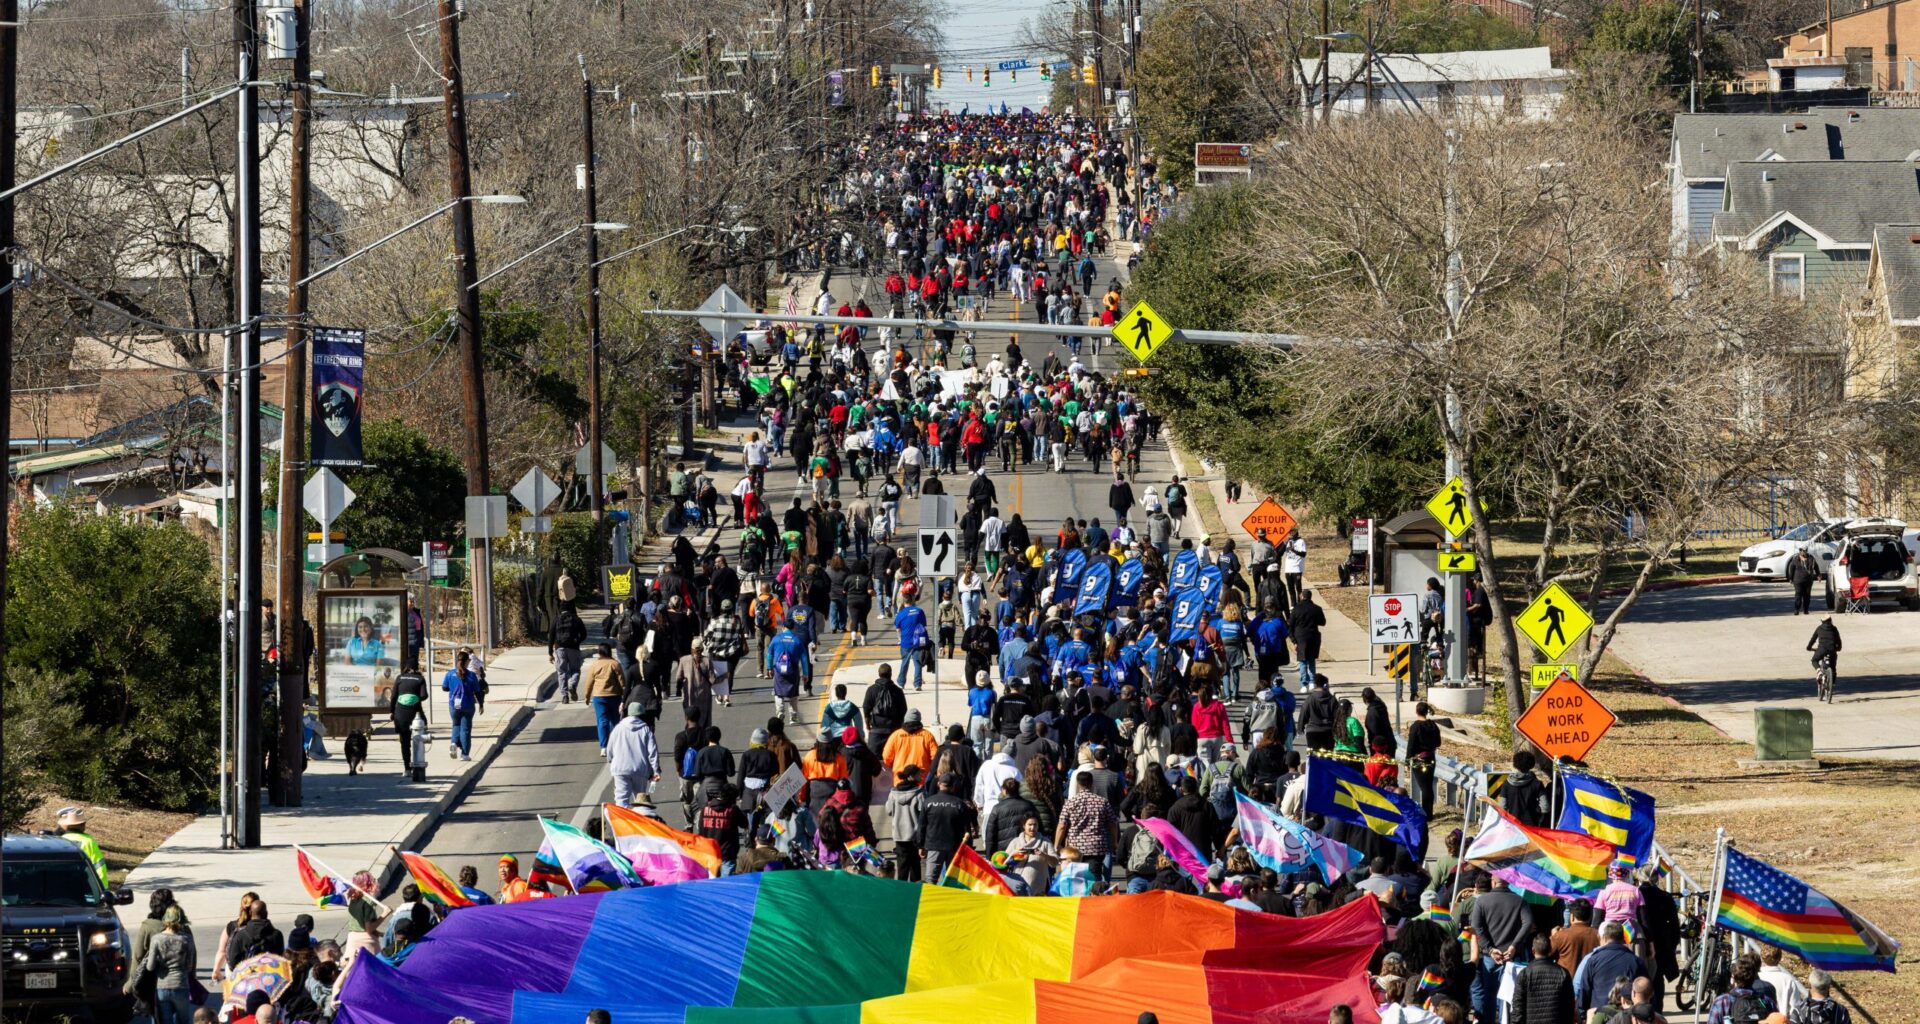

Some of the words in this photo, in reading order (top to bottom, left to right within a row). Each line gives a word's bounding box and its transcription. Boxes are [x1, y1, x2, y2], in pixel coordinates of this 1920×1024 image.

[1002, 60, 1024, 70] Clark
[315, 329, 363, 343] MLK
[314, 355, 323, 365] LET
[349, 356, 363, 367] RING
[1251, 515, 1287, 524] DETOUR
[1253, 526, 1286, 535] AEAD
[1385, 603, 1401, 611] STOP
[1547, 696, 1583, 709] ROAD
[1547, 713, 1584, 727] WORK
[1545, 731, 1590, 745] AHEAD
